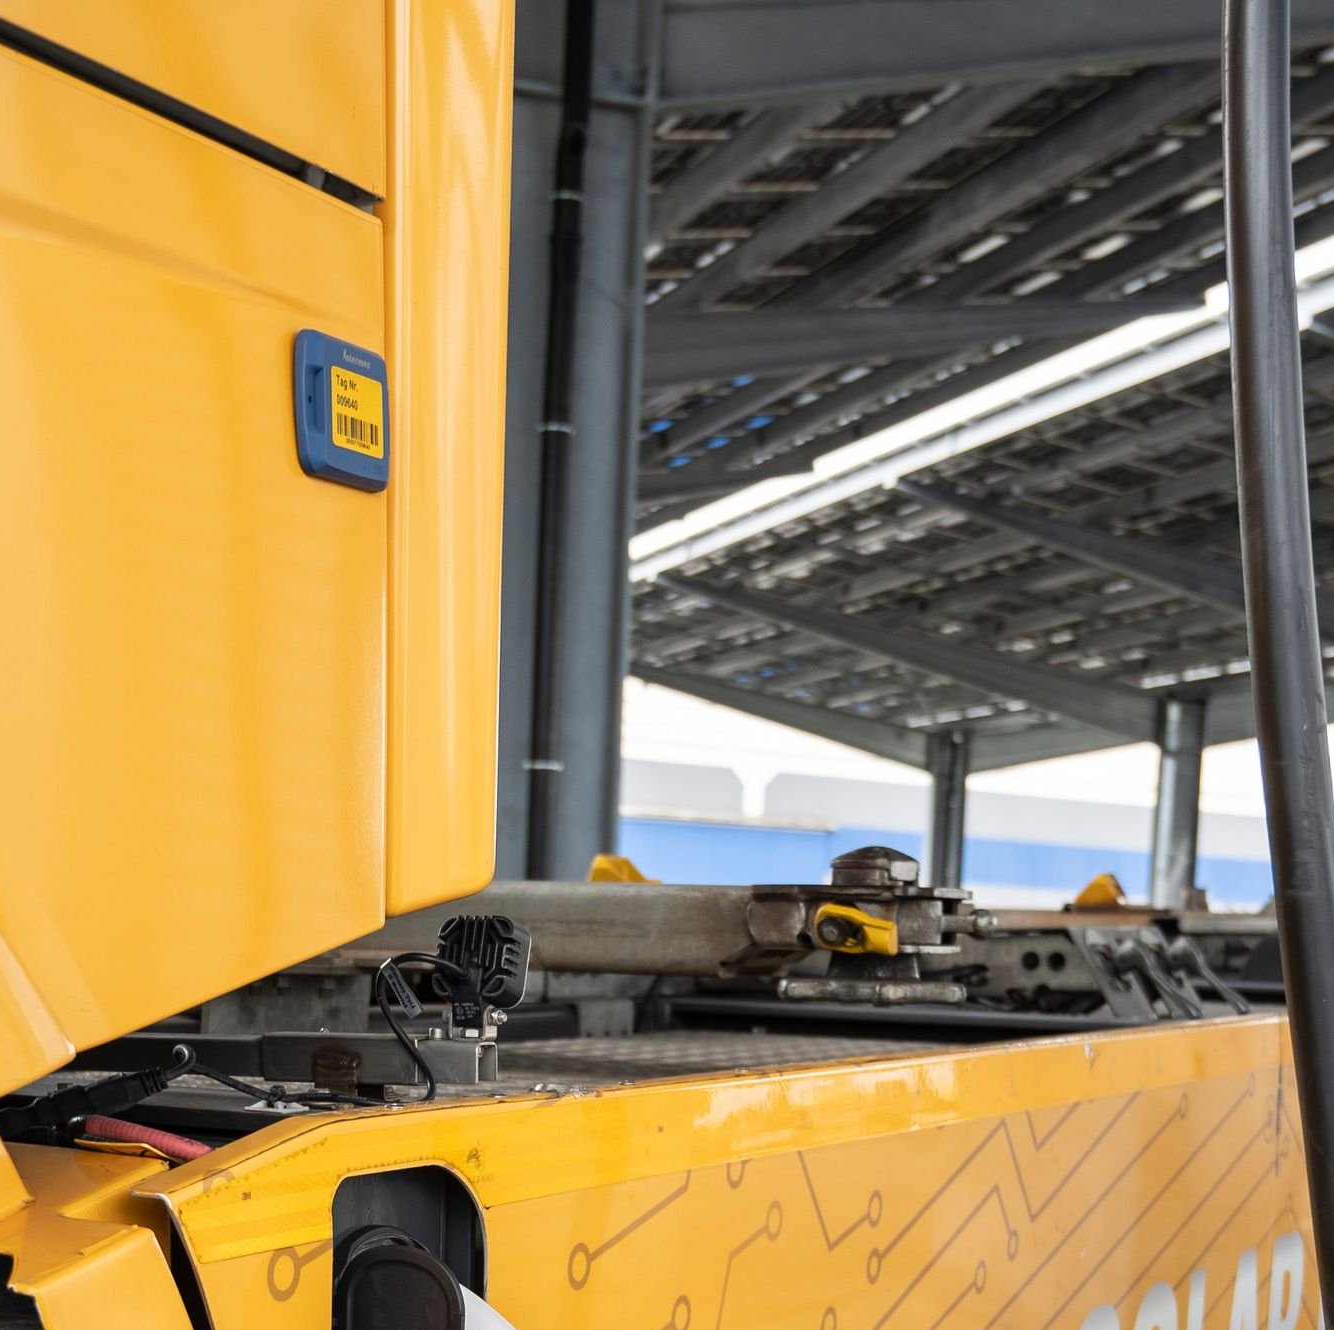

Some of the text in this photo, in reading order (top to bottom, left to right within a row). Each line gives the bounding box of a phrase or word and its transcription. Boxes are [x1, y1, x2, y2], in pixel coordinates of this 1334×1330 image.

[336, 374, 358, 392] Tag Nr.
[336, 394, 359, 411] 009640
